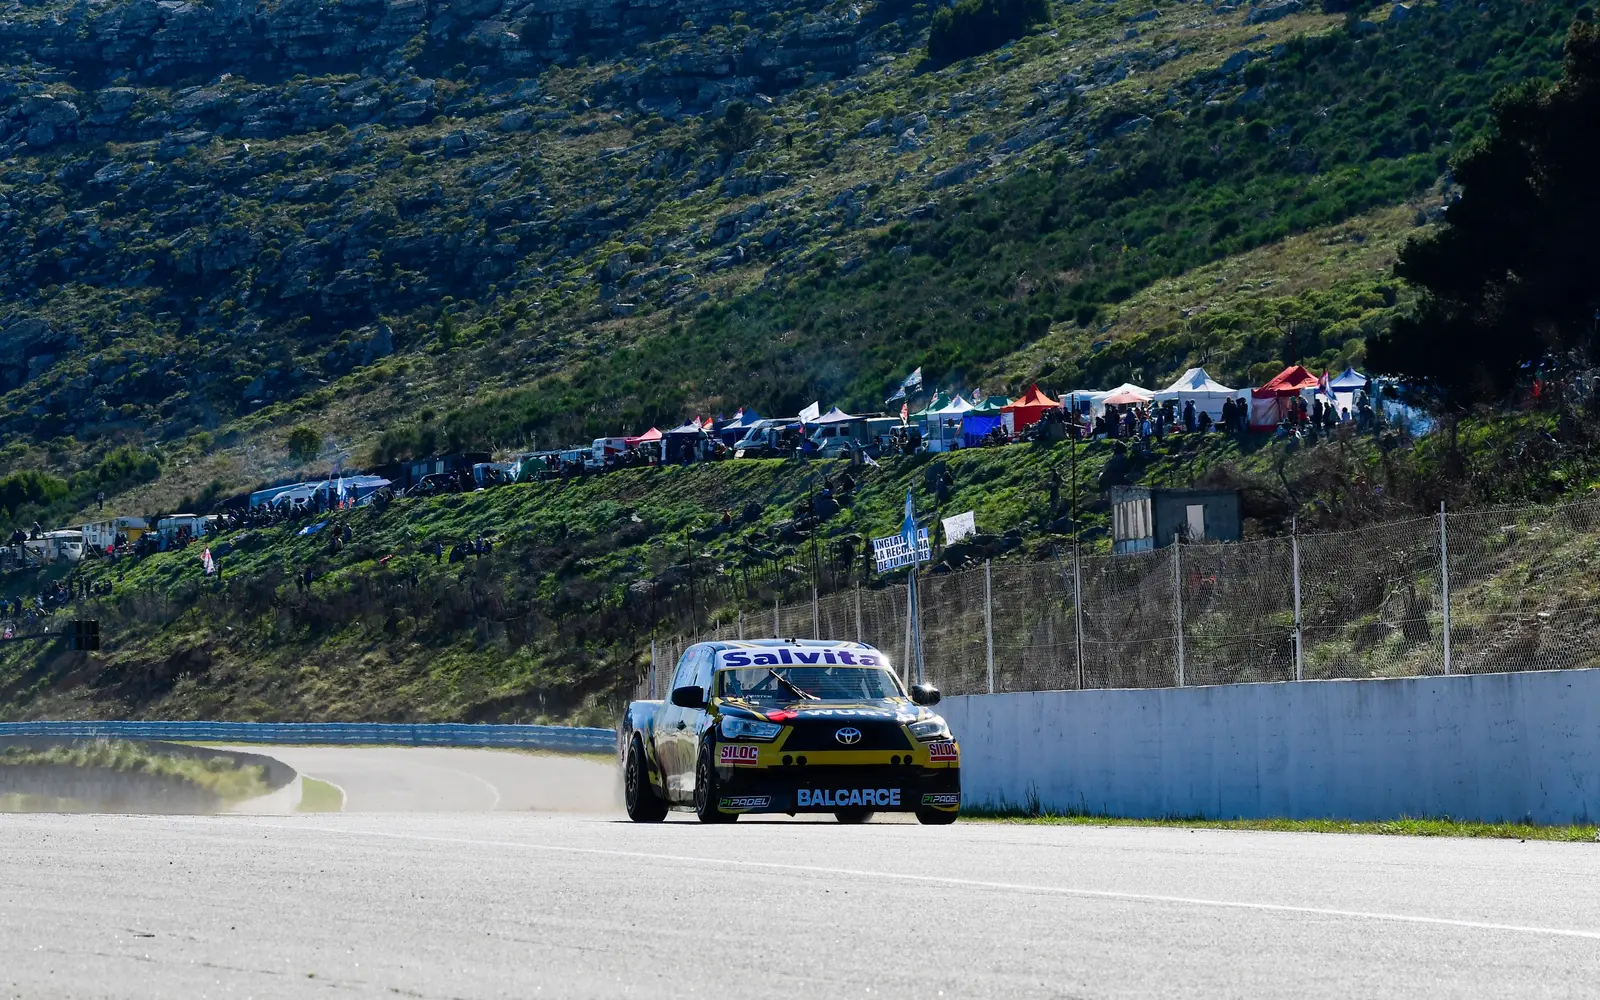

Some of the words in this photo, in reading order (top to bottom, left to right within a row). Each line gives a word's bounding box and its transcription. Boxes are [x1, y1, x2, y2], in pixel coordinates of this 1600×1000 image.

[875, 550, 886, 561] LA
[886, 538, 928, 558] RECOHA
[876, 530, 924, 550] INGLATA
[879, 560, 888, 571] DE
[889, 555, 899, 567] TU
[901, 549, 928, 565] MARE
[722, 648, 883, 667] Salvita
[721, 746, 758, 759] SILOC
[928, 743, 957, 756] SILOC
[797, 788, 901, 807] BALCARCE
